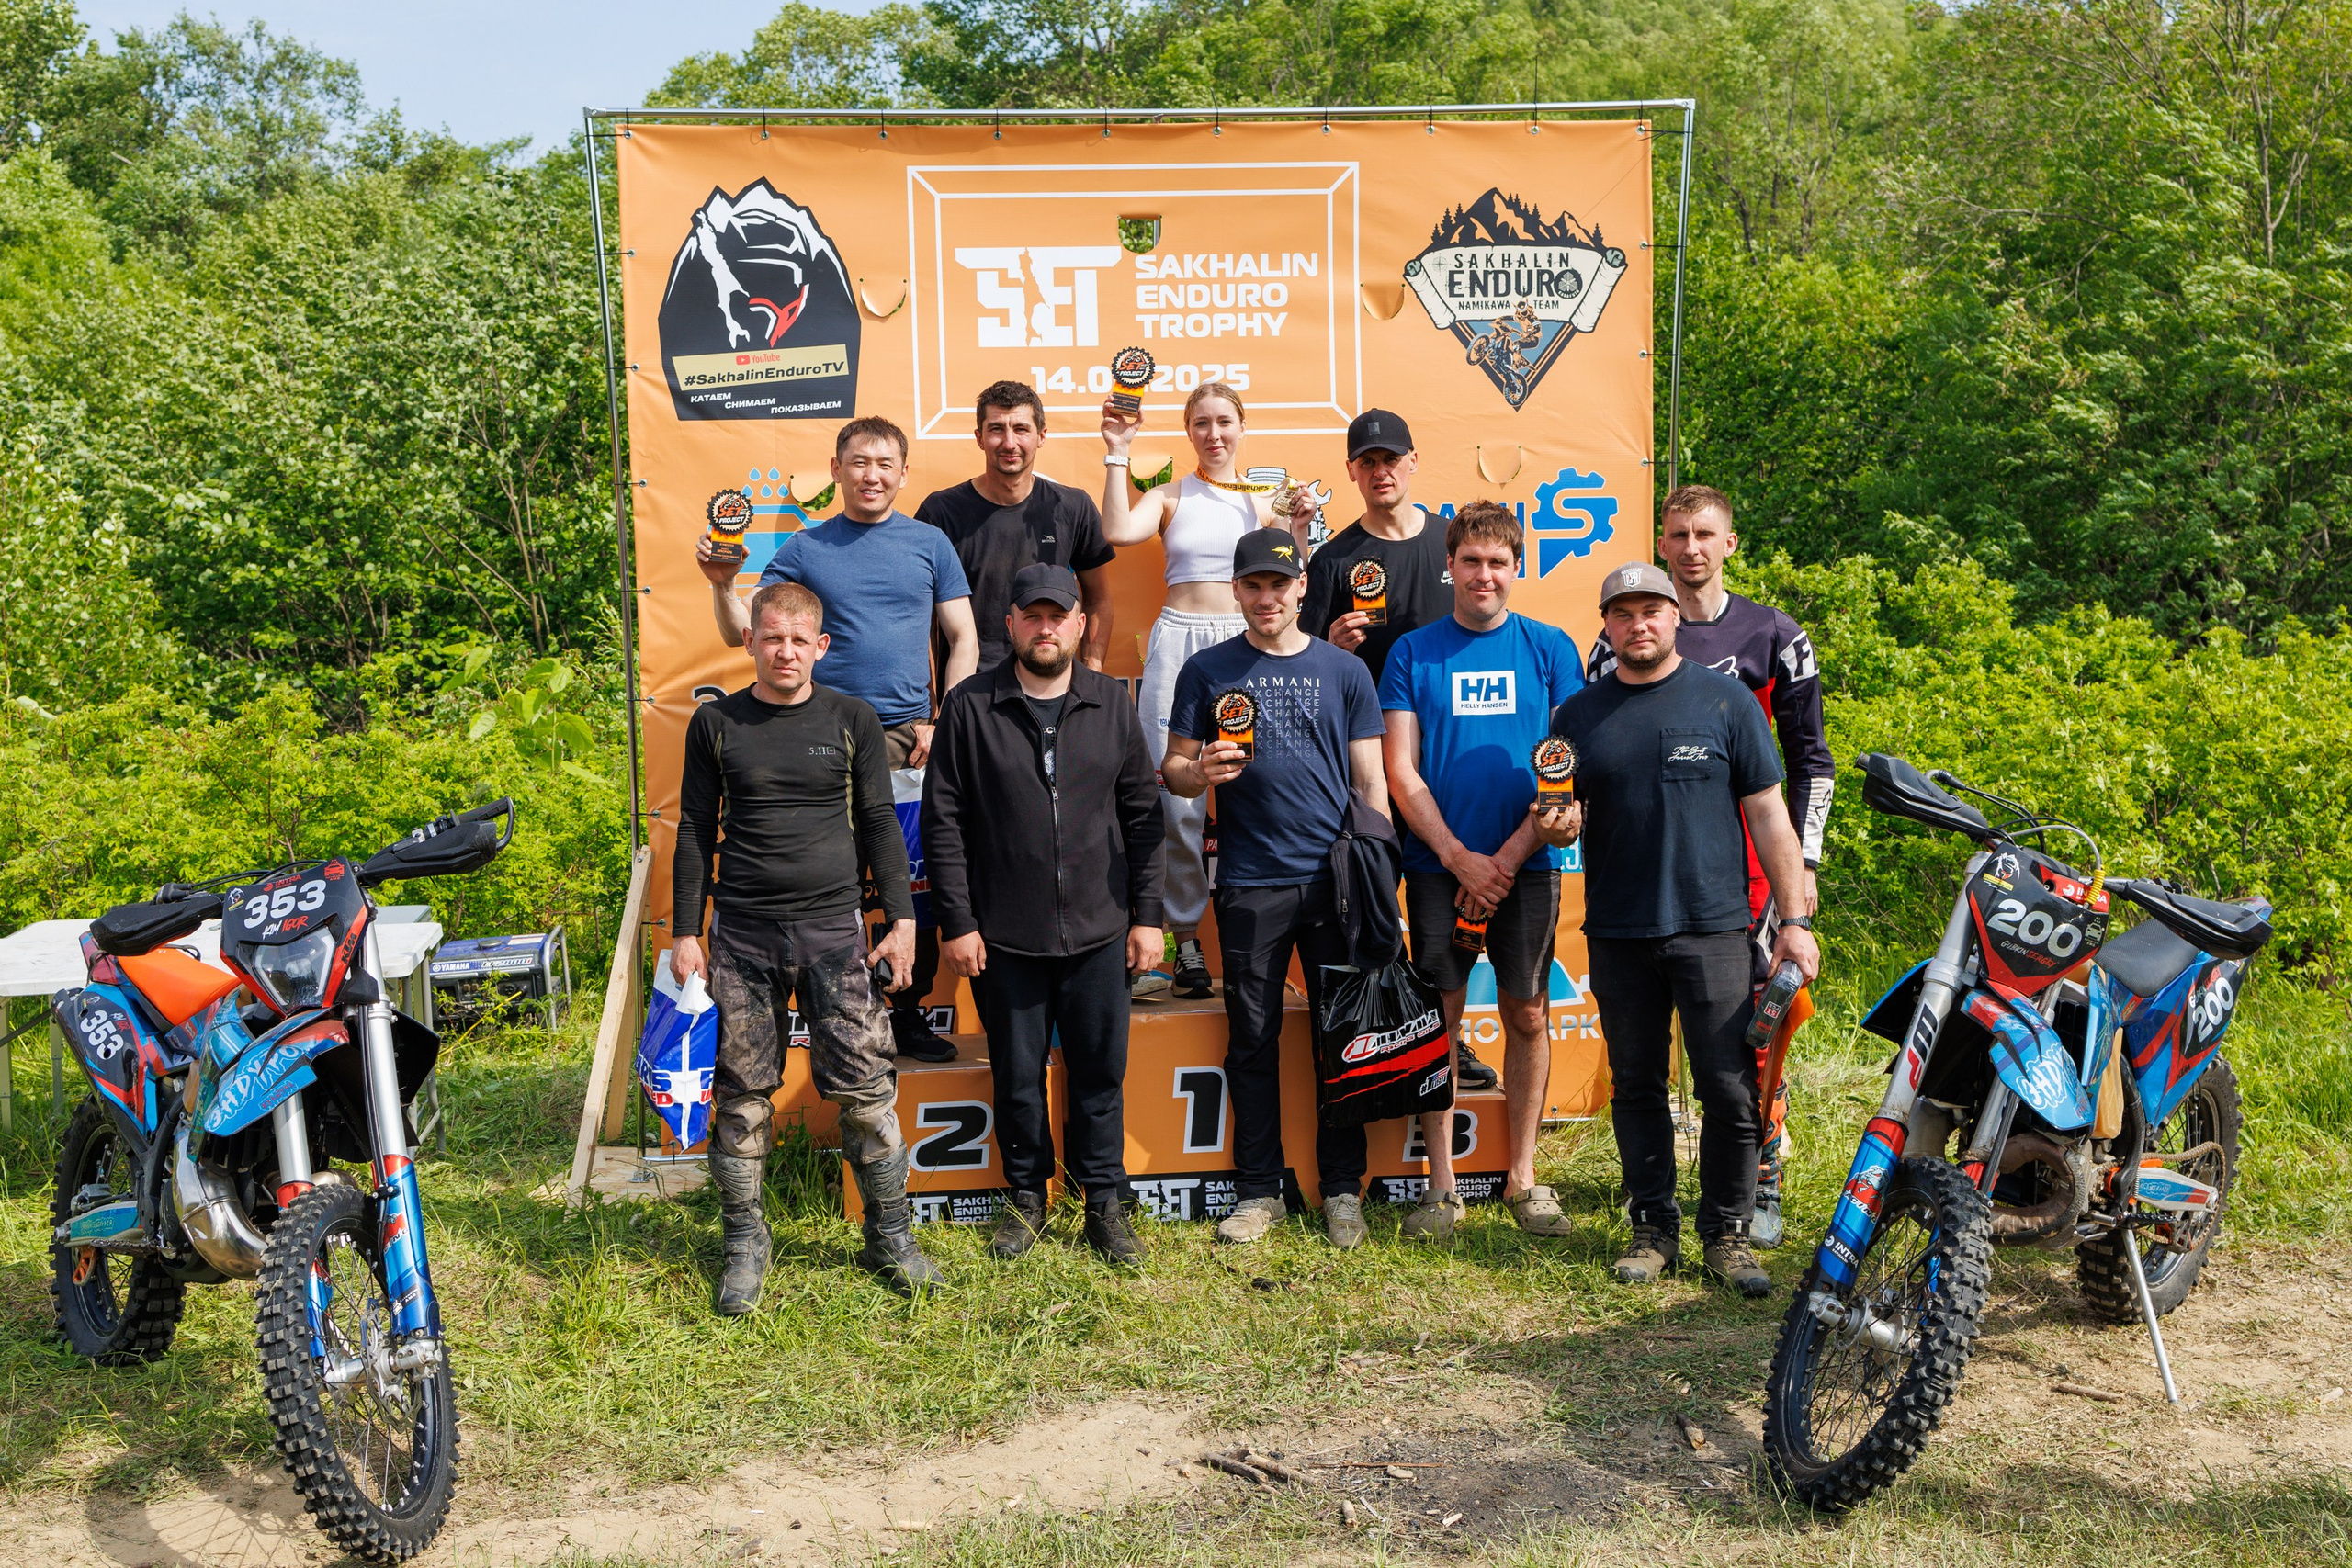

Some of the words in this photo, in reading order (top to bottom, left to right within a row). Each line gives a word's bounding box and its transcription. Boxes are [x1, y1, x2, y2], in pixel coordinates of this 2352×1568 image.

[1135, 253, 1317, 279] SAKHALIN
[1454, 252, 1569, 268] SAKHALIN
[955, 246, 1122, 347] SET
[1136, 283, 1289, 310] ENDURO
[1459, 300, 1510, 310] NAMIKAWA
[1533, 299, 1559, 309] TEAM
[1136, 311, 1289, 339] TROPHY
[751, 353, 781, 364] YouTube
[684, 361, 844, 386] #SakhalinEnduroTV
[1118, 362, 1143, 371] SET
[691, 392, 731, 403] КАТАЕМ
[725, 398, 775, 410] СНИМАЕМ
[771, 400, 842, 414] ПОКАЗЫВАЕМ
[717, 507, 743, 517] SET
[1354, 573, 1379, 587] SET
[1357, 581, 1380, 592] PROJECT
[1246, 677, 1320, 688] ARMANI
[1249, 688, 1320, 698] XCHANGE
[1220, 706, 1246, 720] SET
[1223, 716, 1248, 727] PROJECT
[1540, 752, 1567, 767] SET
[1544, 761, 1568, 773] PROJECT
[276, 874, 301, 886] INTRA
[243, 879, 326, 929] 353
[262, 919, 283, 940] KIM
[282, 915, 309, 932] IGOR
[1986, 898, 2082, 958] 200
[2001, 940, 2028, 955] GUBKIN
[2027, 950, 2057, 968] SERGEY
[441, 963, 470, 971] YAMAHA
[2192, 977, 2234, 1043] 200
[80, 1010, 124, 1060] 353
[1417, 1022, 1441, 1039] OILS
[1172, 1066, 1228, 1154] 1
[910, 1100, 993, 1171] 2
[1834, 1241, 1859, 1269] INTRA
